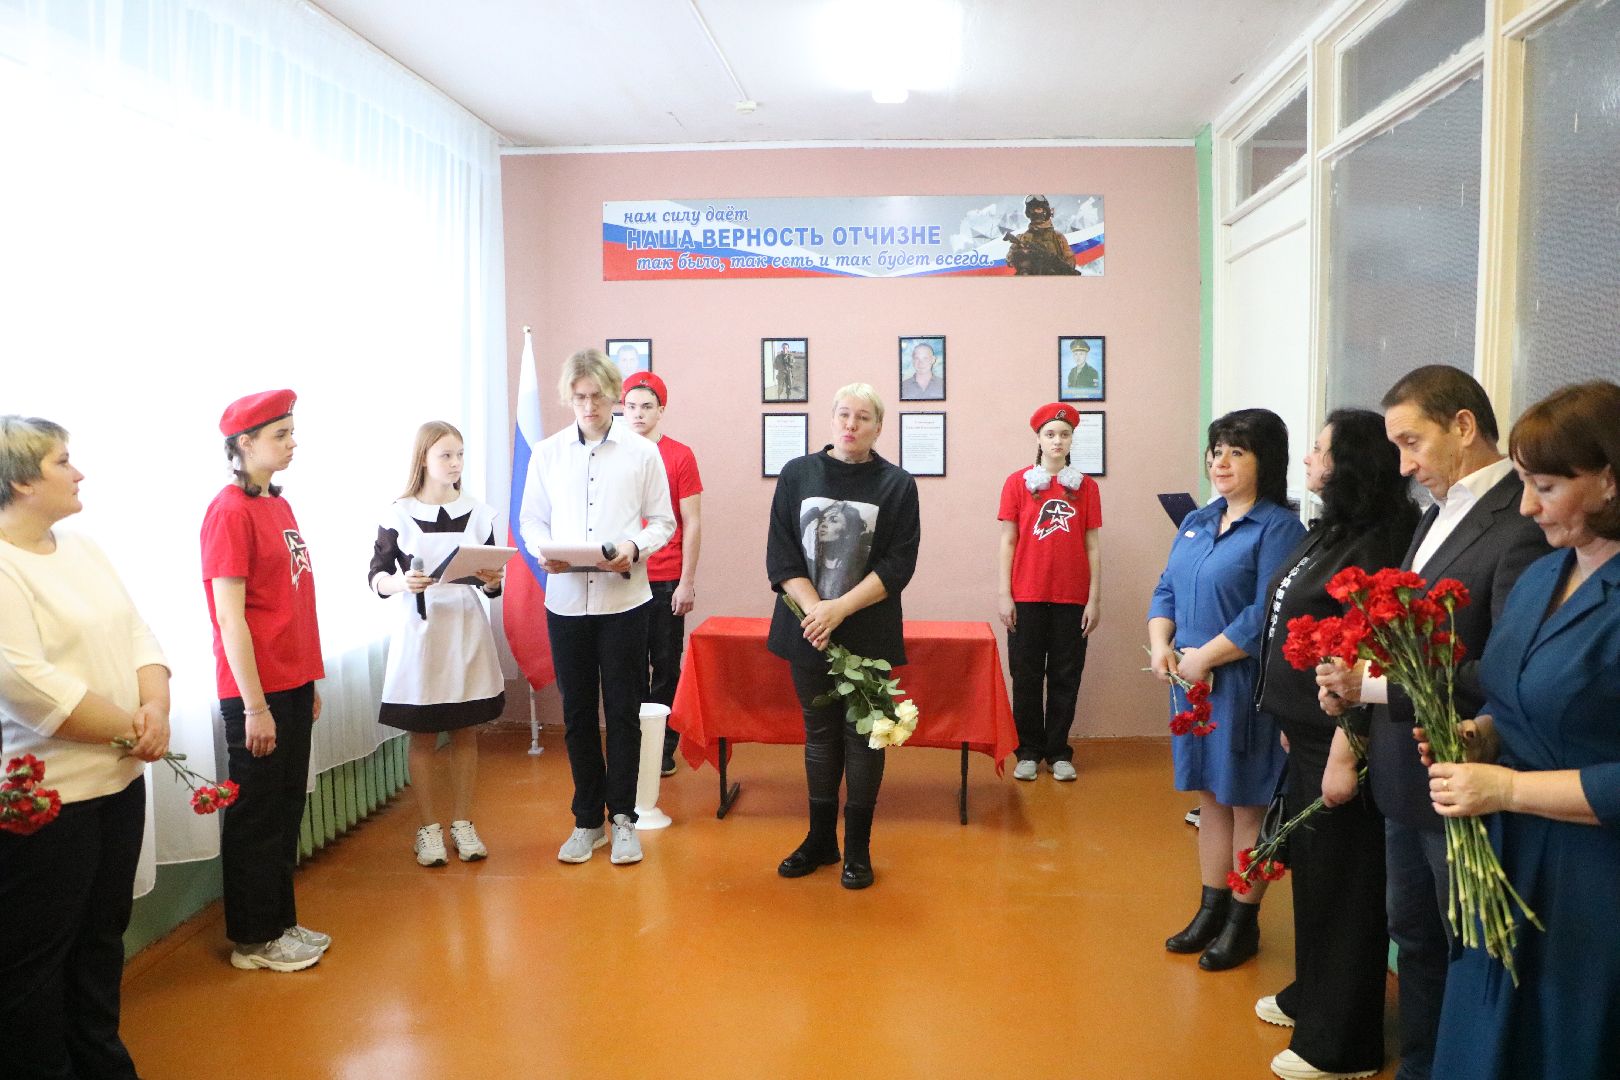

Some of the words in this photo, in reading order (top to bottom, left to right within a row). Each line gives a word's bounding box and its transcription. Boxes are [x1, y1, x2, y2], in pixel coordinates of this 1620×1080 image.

[623, 211, 657, 223] нам
[662, 210, 701, 226] силу
[705, 206, 749, 222] даёт
[627, 229, 695, 249] НАША
[702, 227, 824, 248] ВЕРНОСТЬ
[832, 225, 941, 246] ОТЧИЗНЕ
[637, 256, 673, 270] так
[678, 251, 726, 272] было,
[730, 255, 767, 268] так
[772, 255, 814, 268] есть
[819, 256, 830, 267] и
[835, 255, 872, 267] так
[877, 250, 930, 270] будет
[935, 250, 994, 268] всегда.
